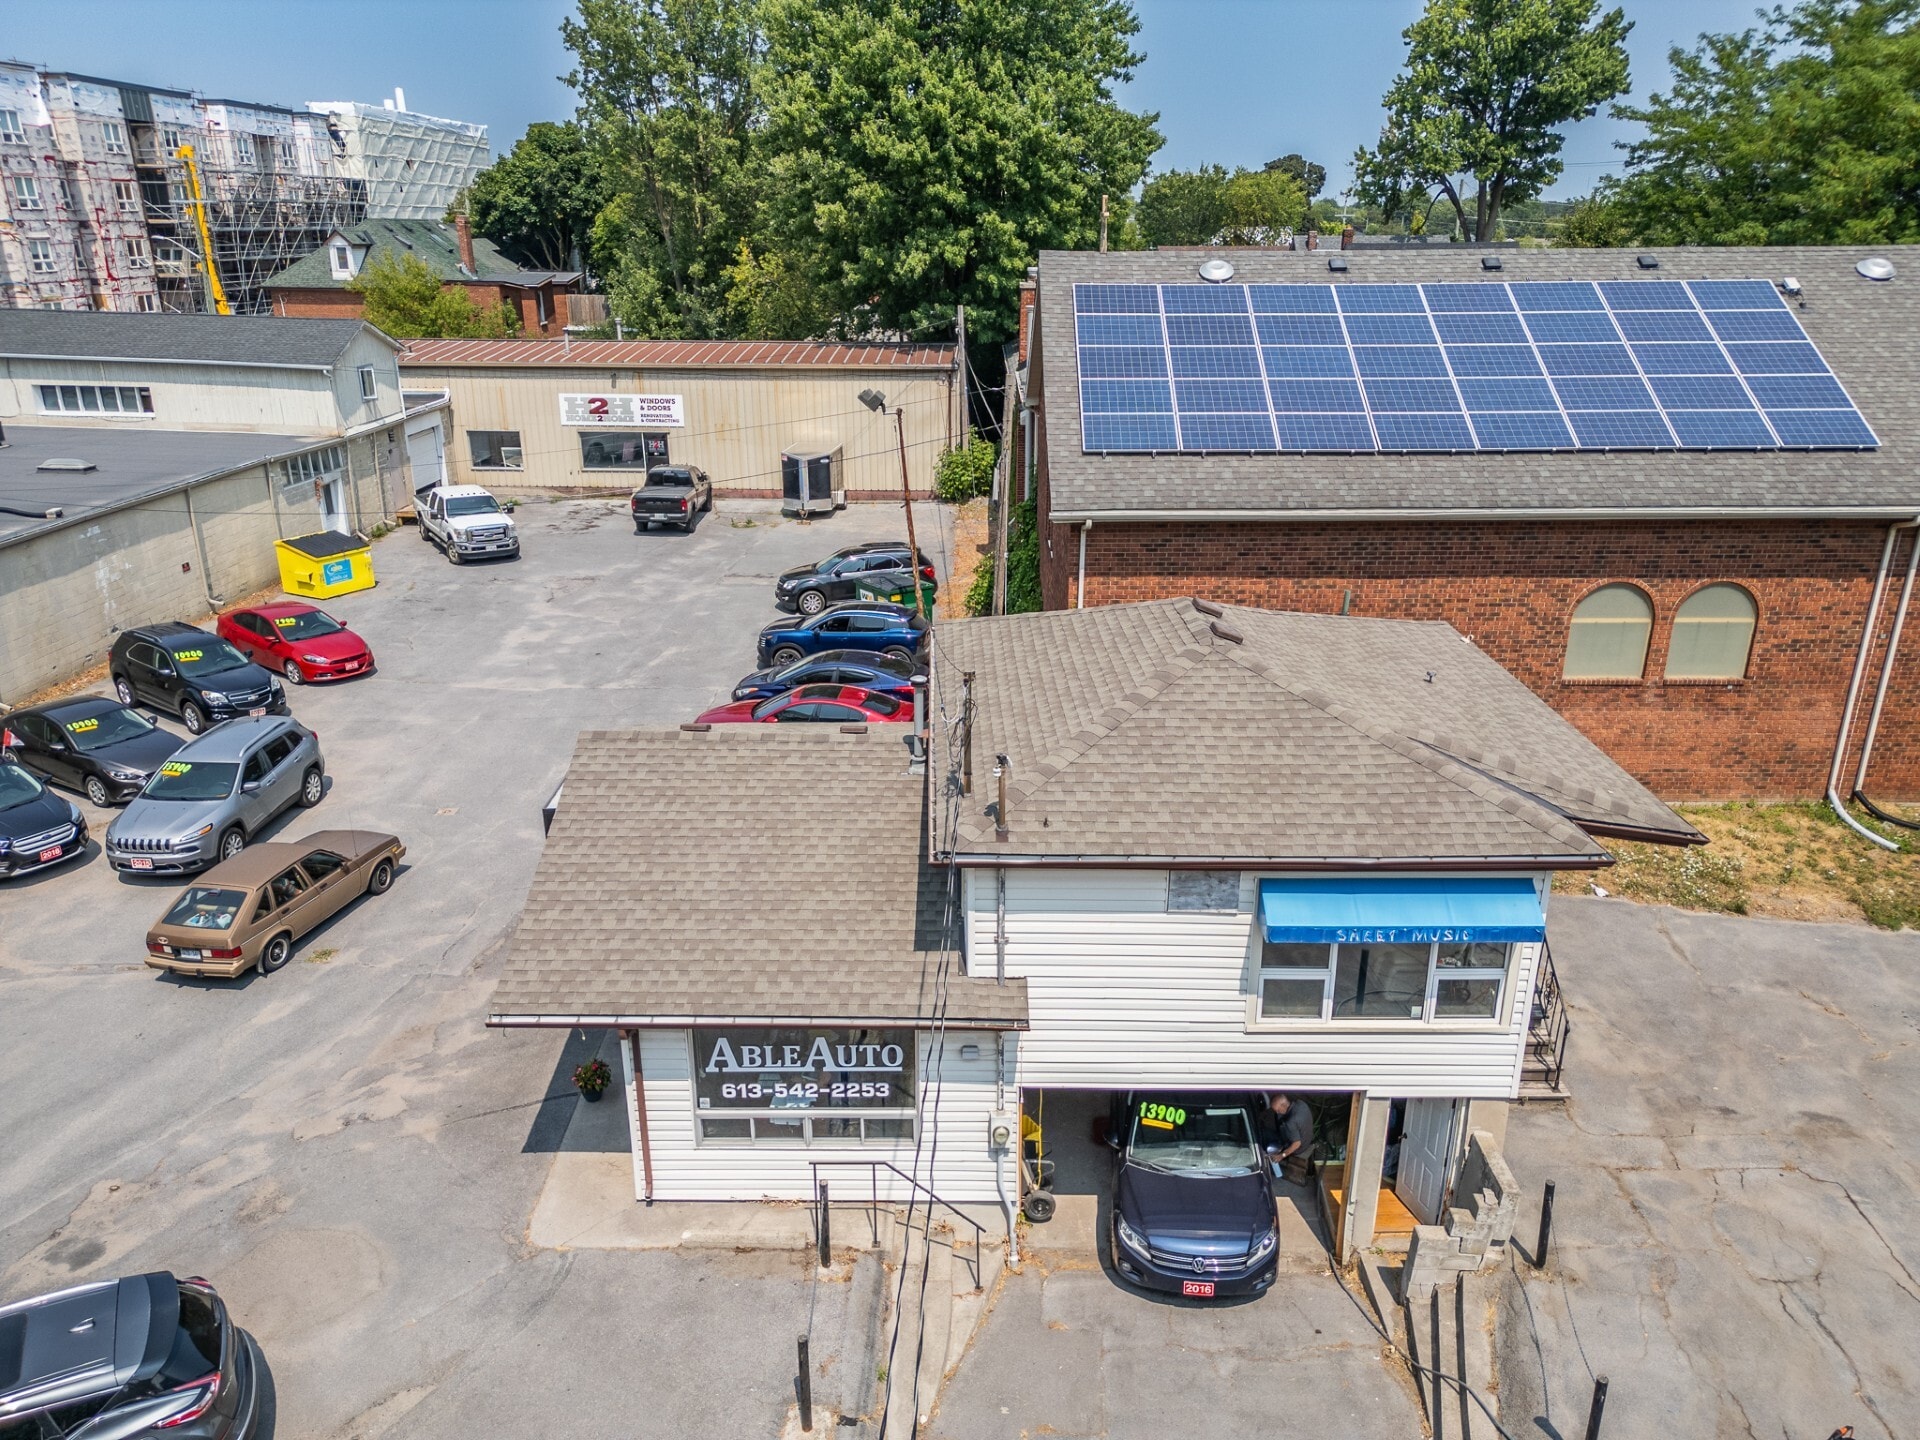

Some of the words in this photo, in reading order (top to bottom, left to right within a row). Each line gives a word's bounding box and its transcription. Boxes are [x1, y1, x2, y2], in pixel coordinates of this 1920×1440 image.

[639, 397, 676, 405] WINDOWS
[173, 649, 203, 660] 10900
[66, 718, 99, 731] 10900
[1412, 928, 1473, 941] MUSIC
[721, 1082, 890, 1099] 613-542-2253
[1140, 1101, 1186, 1125] 13900
[1185, 1284, 1211, 1294] 2016
